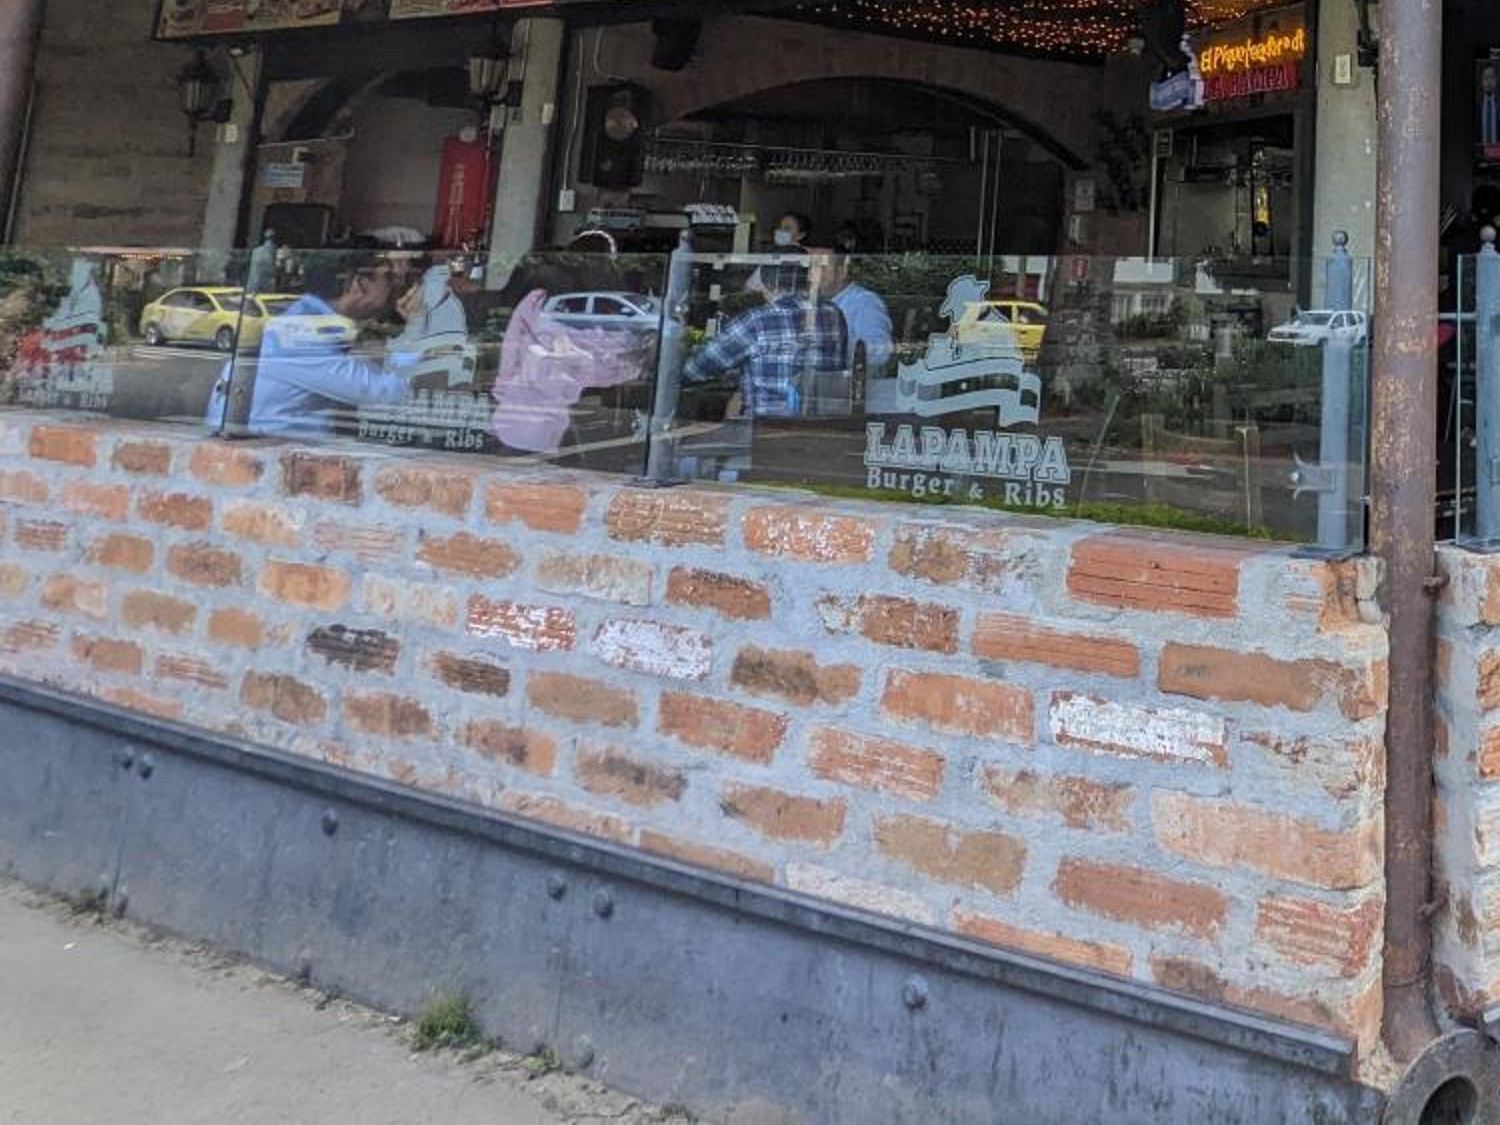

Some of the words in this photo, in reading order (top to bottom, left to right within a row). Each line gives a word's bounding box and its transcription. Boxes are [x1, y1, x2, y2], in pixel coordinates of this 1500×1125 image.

[443, 429, 485, 450] Ribs
[866, 465, 955, 499] Burger
[968, 481, 985, 501] &
[1004, 481, 1066, 509] Ribs
